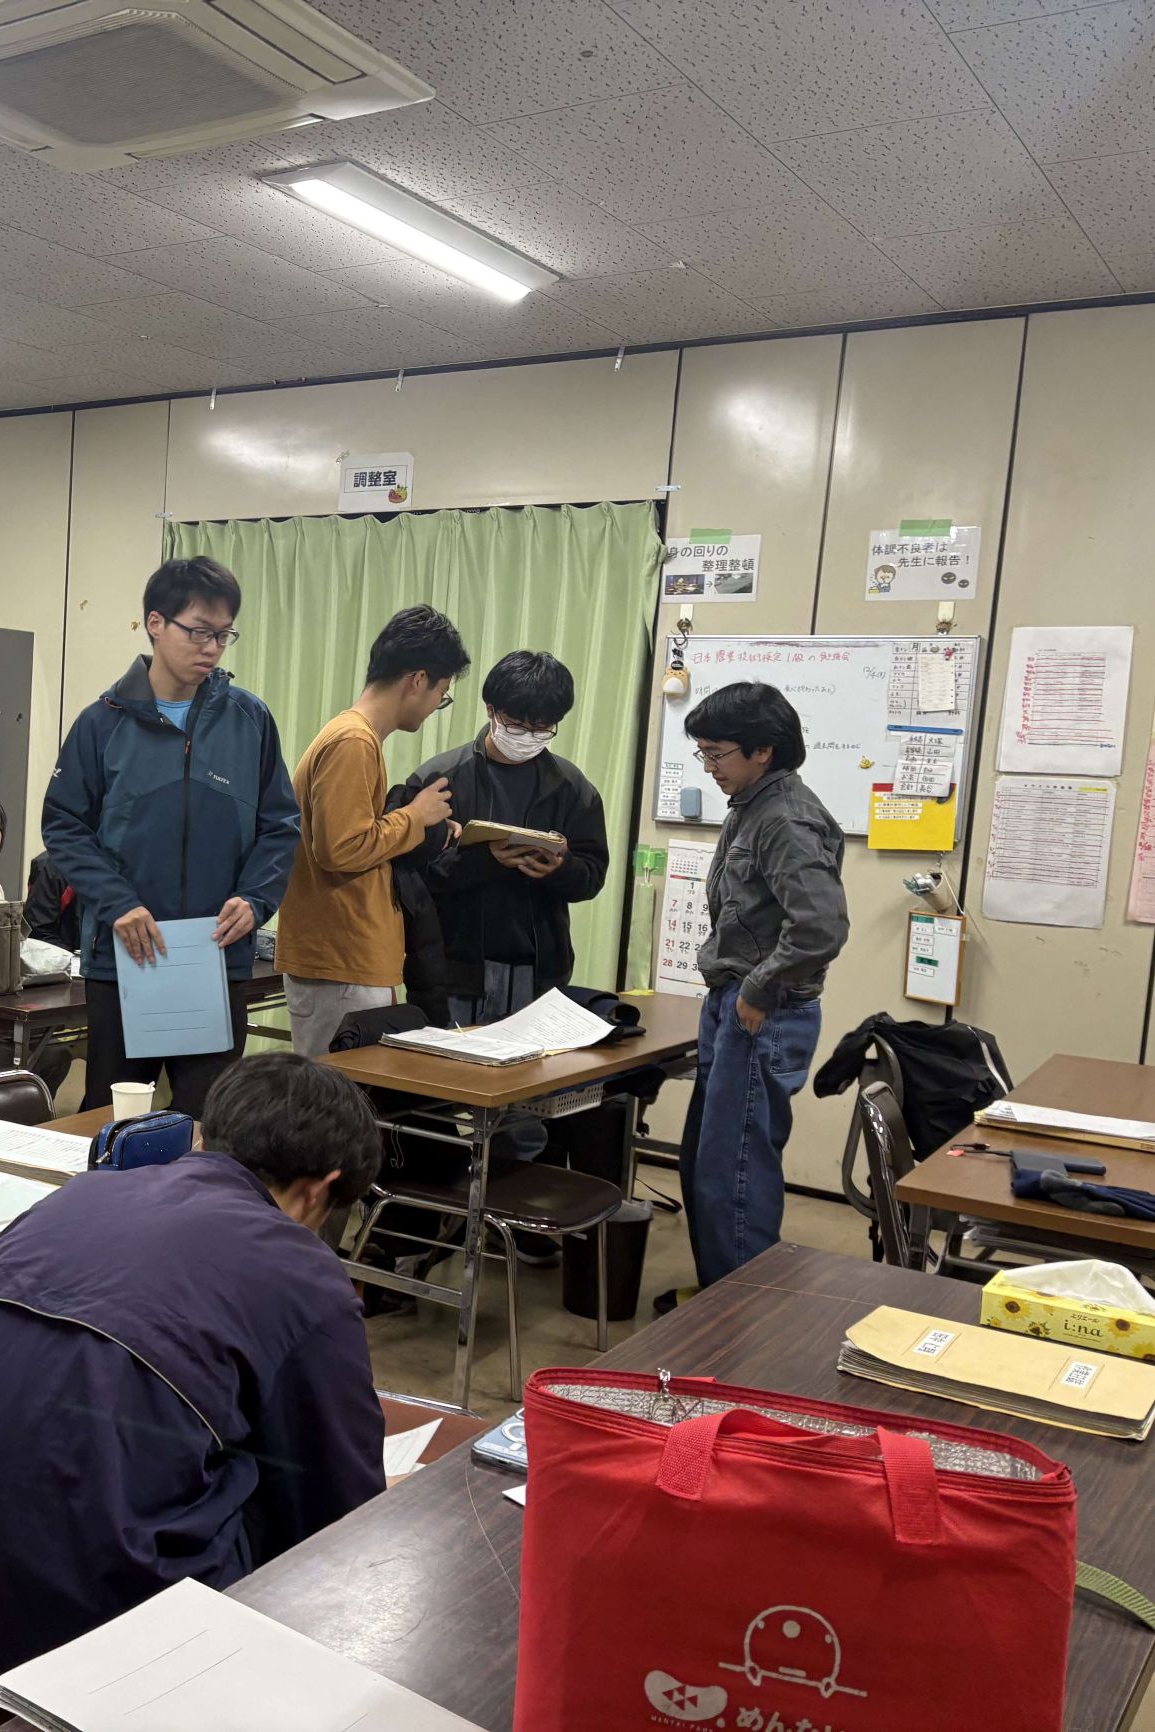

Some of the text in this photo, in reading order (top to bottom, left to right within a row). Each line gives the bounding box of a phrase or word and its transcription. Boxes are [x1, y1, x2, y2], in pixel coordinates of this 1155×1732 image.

[353, 470, 397, 487] 調整室
[667, 545, 729, 558] 身の回りの
[872, 542, 948, 556] 体調不良者は
[702, 558, 755, 572] 整理整頓
[689, 881, 695, 890] 1
[671, 899, 709, 912] 7 8 9
[667, 919, 708, 932] 14 15 16
[665, 938, 675, 948] 21
[679, 941, 690, 951] 22
[662, 958, 699, 971] 28 29 3
[1070, 1313, 1100, 1324] エリエール
[1063, 1319, 1103, 1338] i:na
